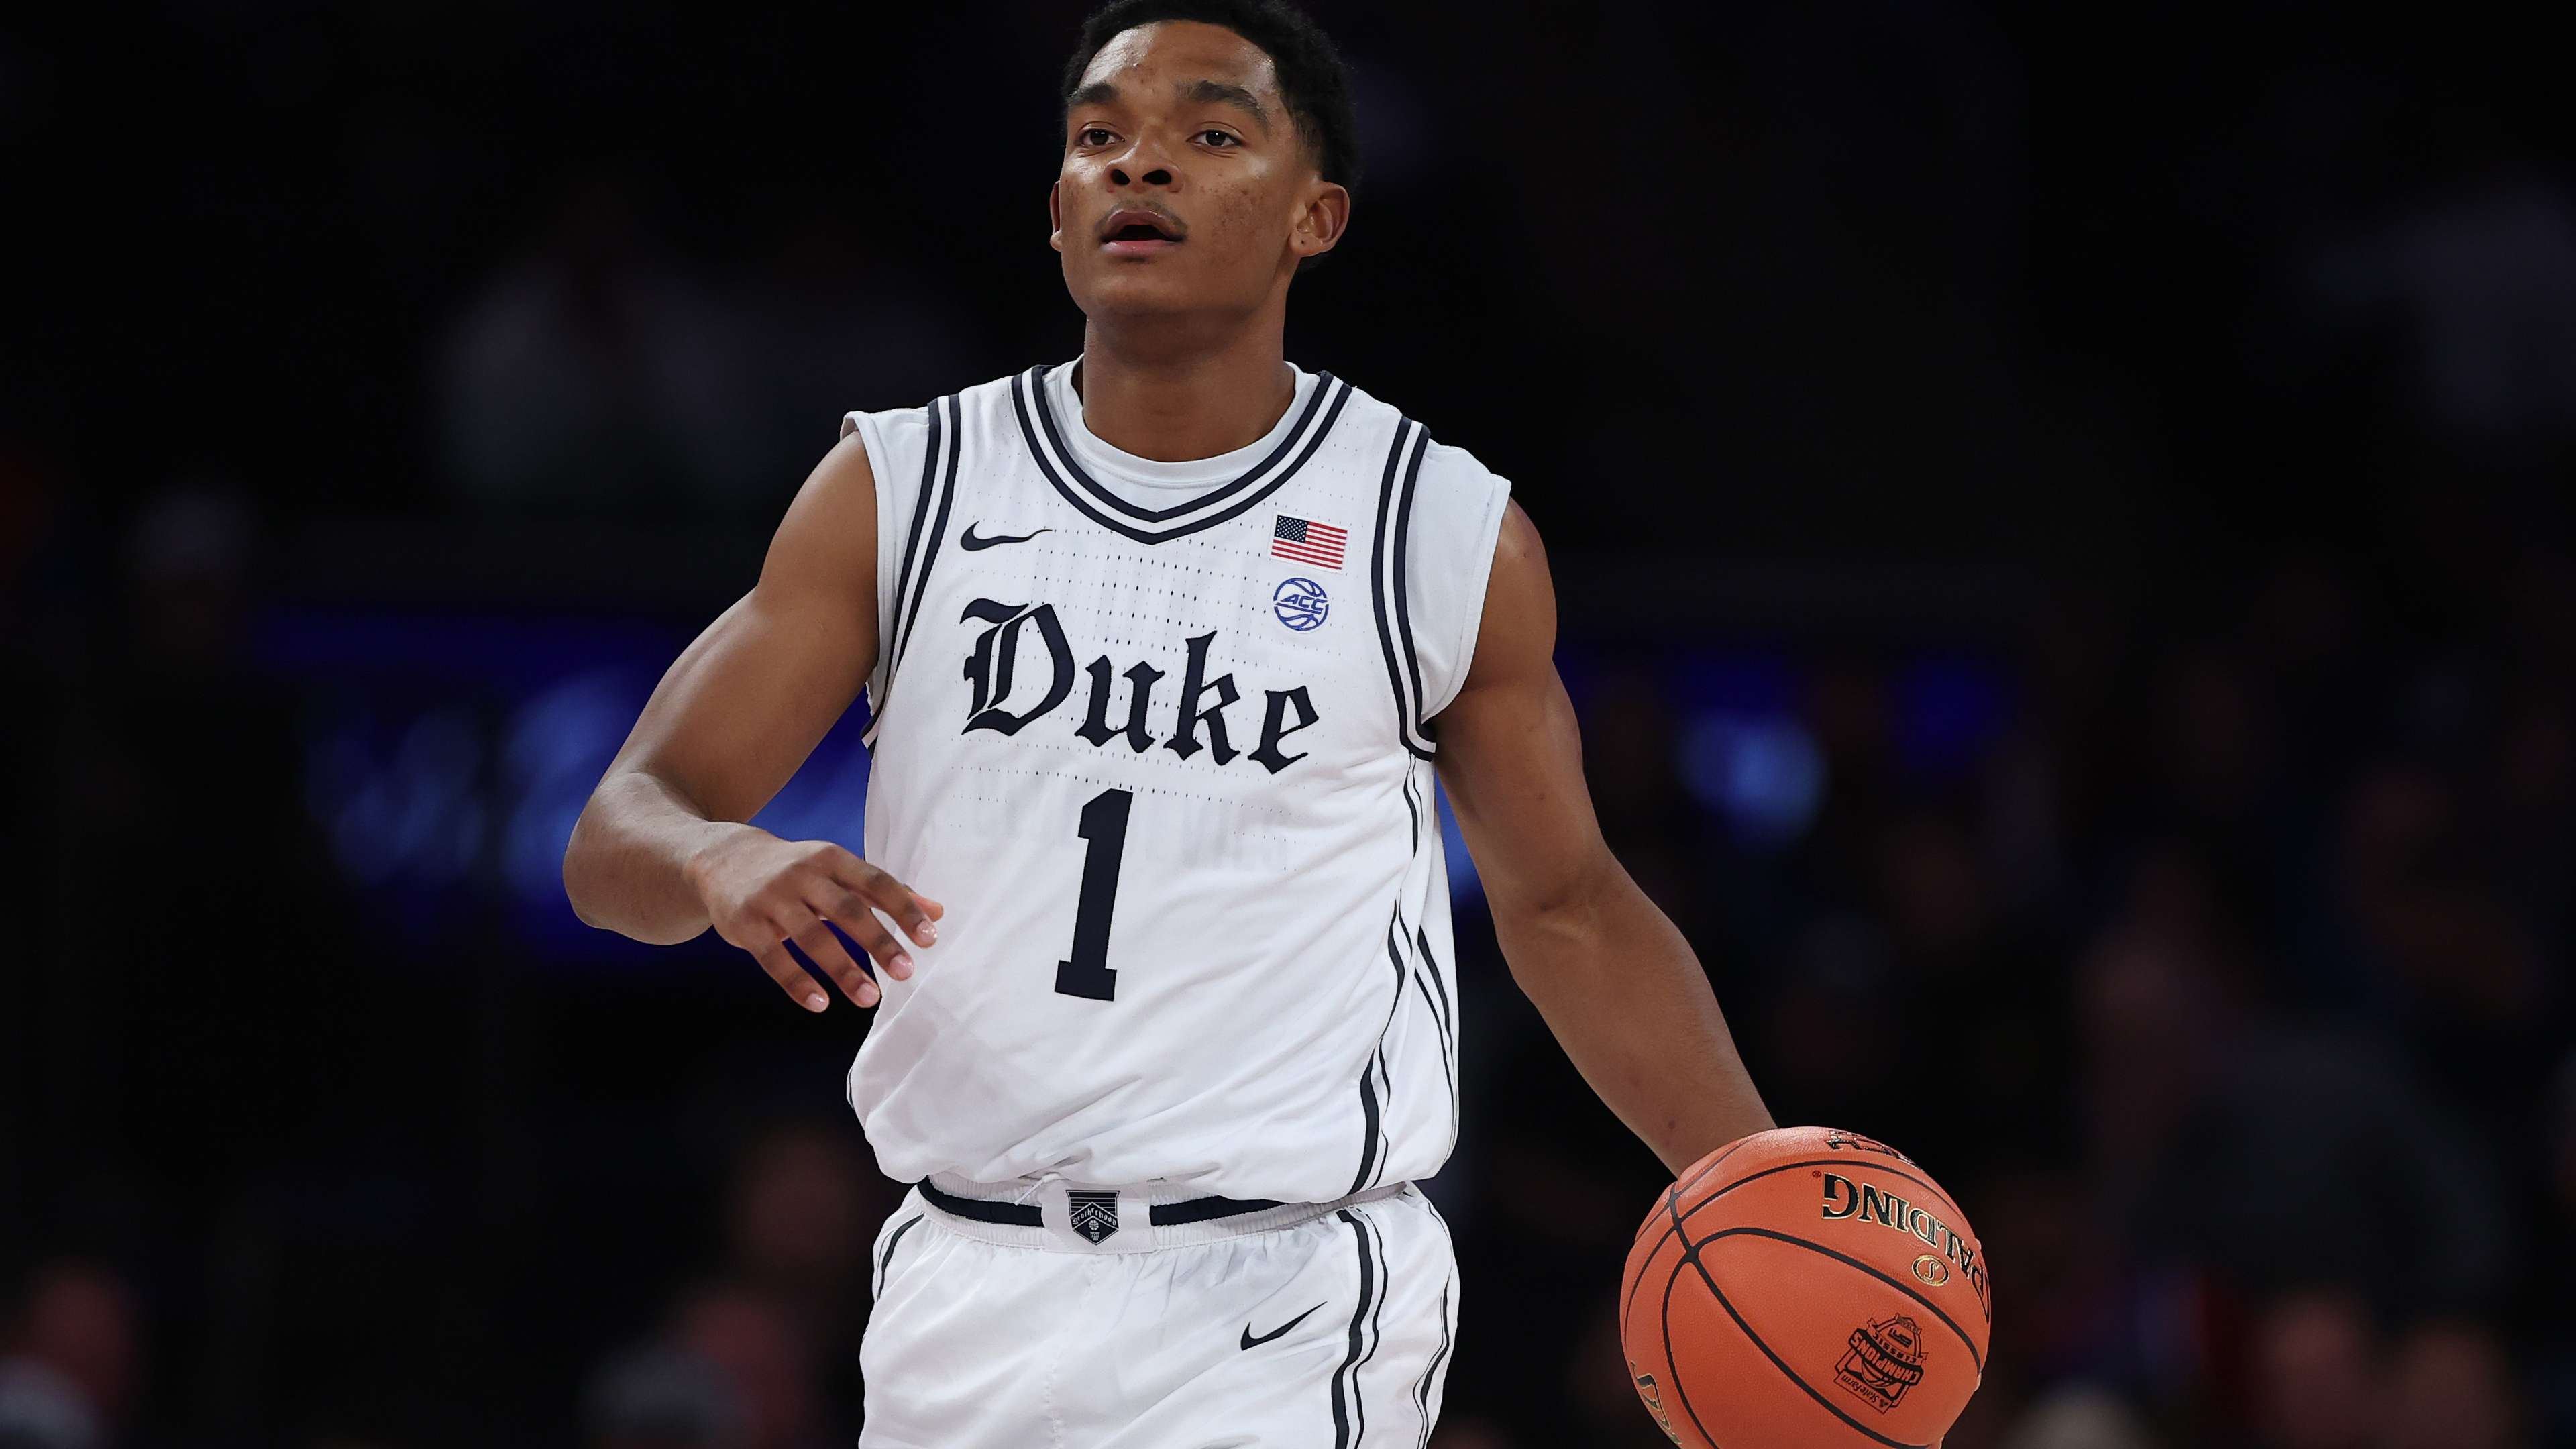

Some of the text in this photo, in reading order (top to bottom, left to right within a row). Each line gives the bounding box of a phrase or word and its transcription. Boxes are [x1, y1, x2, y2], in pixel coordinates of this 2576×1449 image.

[1280, 594, 1328, 612] ACC
[960, 598, 1319, 774] Duke
[1055, 788, 1134, 1002] 1
[1850, 1332, 1921, 1383] CHAMPIONS
[1872, 1332, 1917, 1363] CLASSIC
